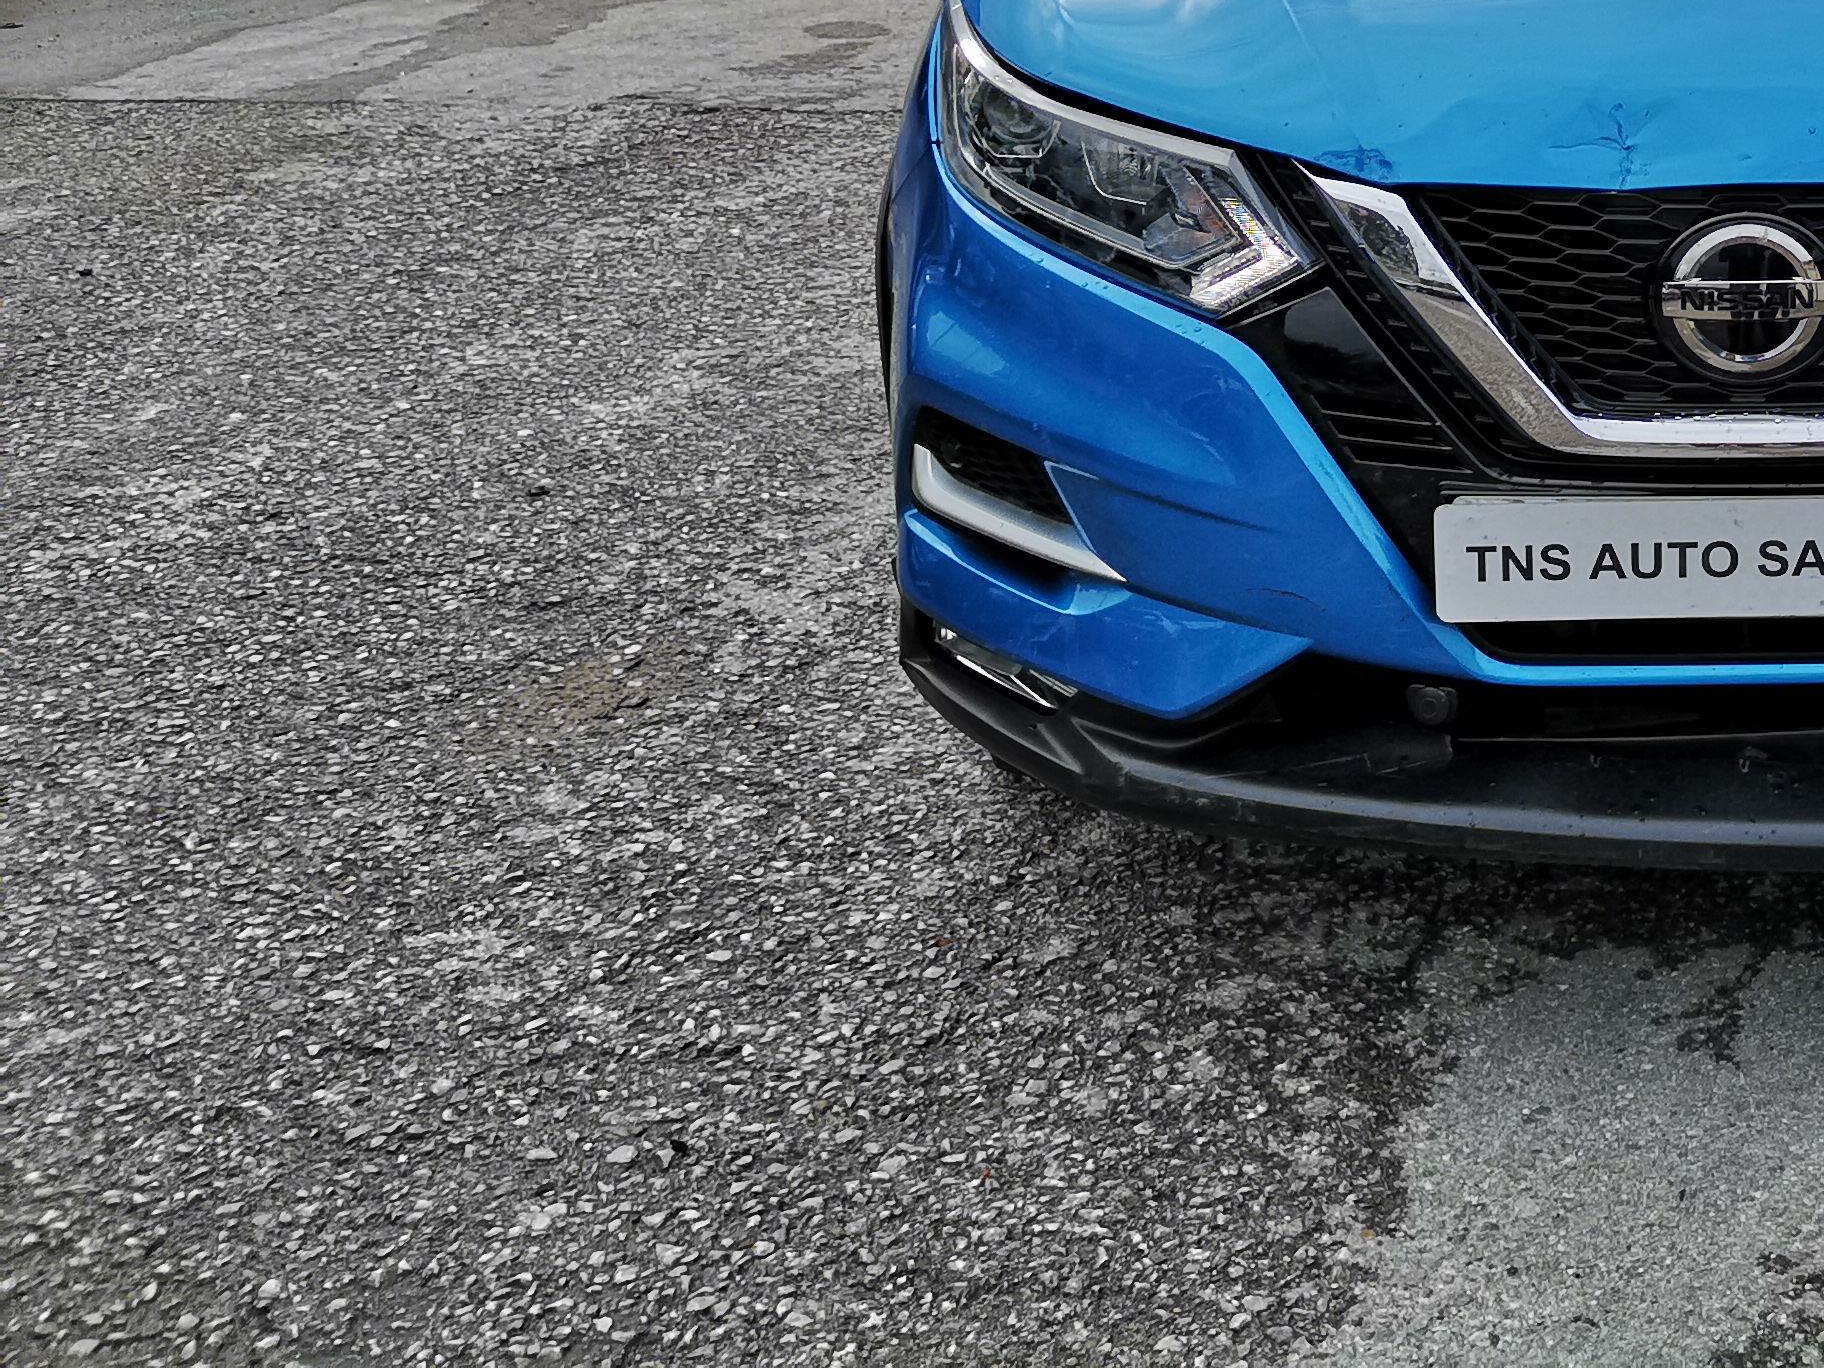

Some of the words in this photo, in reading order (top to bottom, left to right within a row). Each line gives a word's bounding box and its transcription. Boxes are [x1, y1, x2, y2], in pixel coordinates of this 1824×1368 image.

[1680, 284, 1815, 311] NISSAN
[1465, 543, 1572, 582] TNS
[1588, 540, 1739, 580] AUTO
